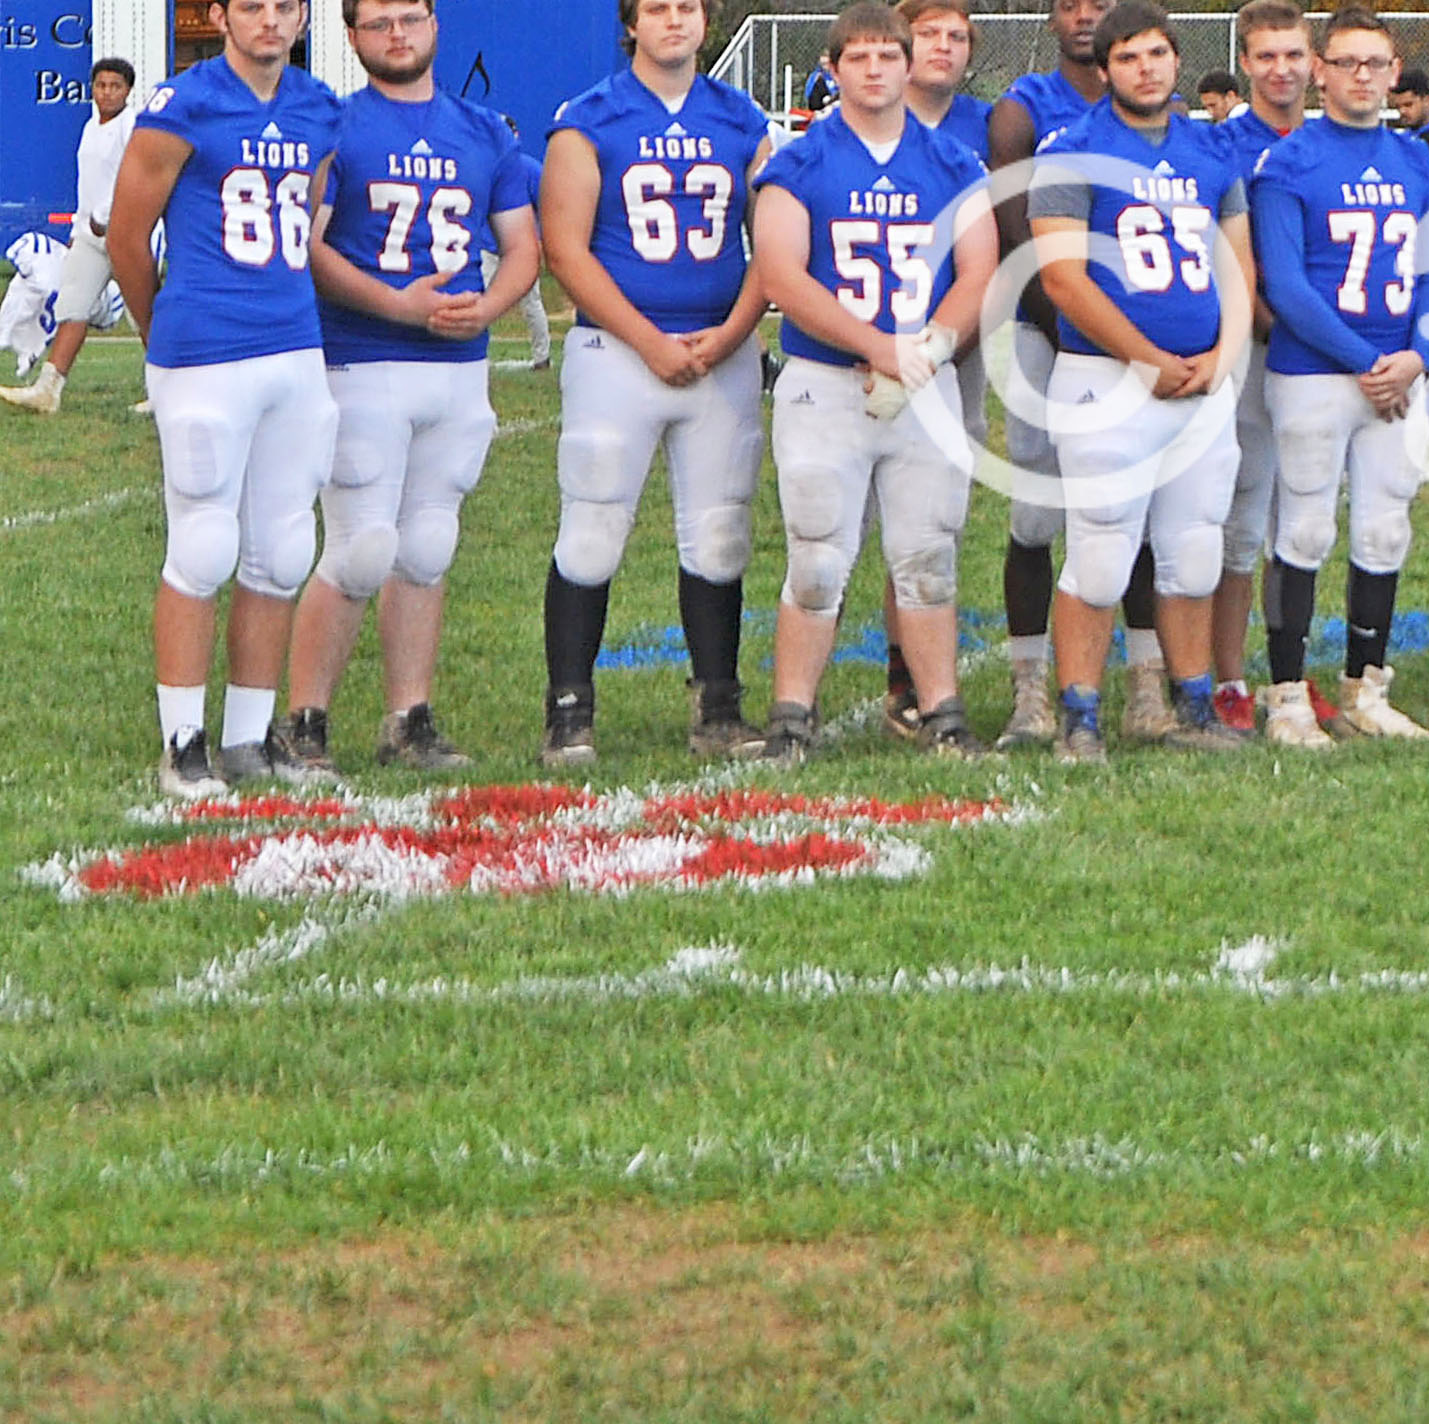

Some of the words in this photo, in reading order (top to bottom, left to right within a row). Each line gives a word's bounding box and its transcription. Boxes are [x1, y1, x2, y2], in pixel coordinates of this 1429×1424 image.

[0, 16, 39, 49] is
[241, 138, 309, 168] LIONS
[638, 136, 713, 159] LIONS
[388, 153, 457, 181] LIONS
[849, 190, 919, 217] LIONS
[1132, 176, 1199, 202] LIONS
[1341, 182, 1406, 206] LIONS
[219, 165, 312, 272] 86
[367, 180, 473, 274] 76
[621, 161, 733, 263] 63
[1116, 203, 1211, 293] 65
[1327, 208, 1418, 316] 73
[830, 219, 936, 325] 55
